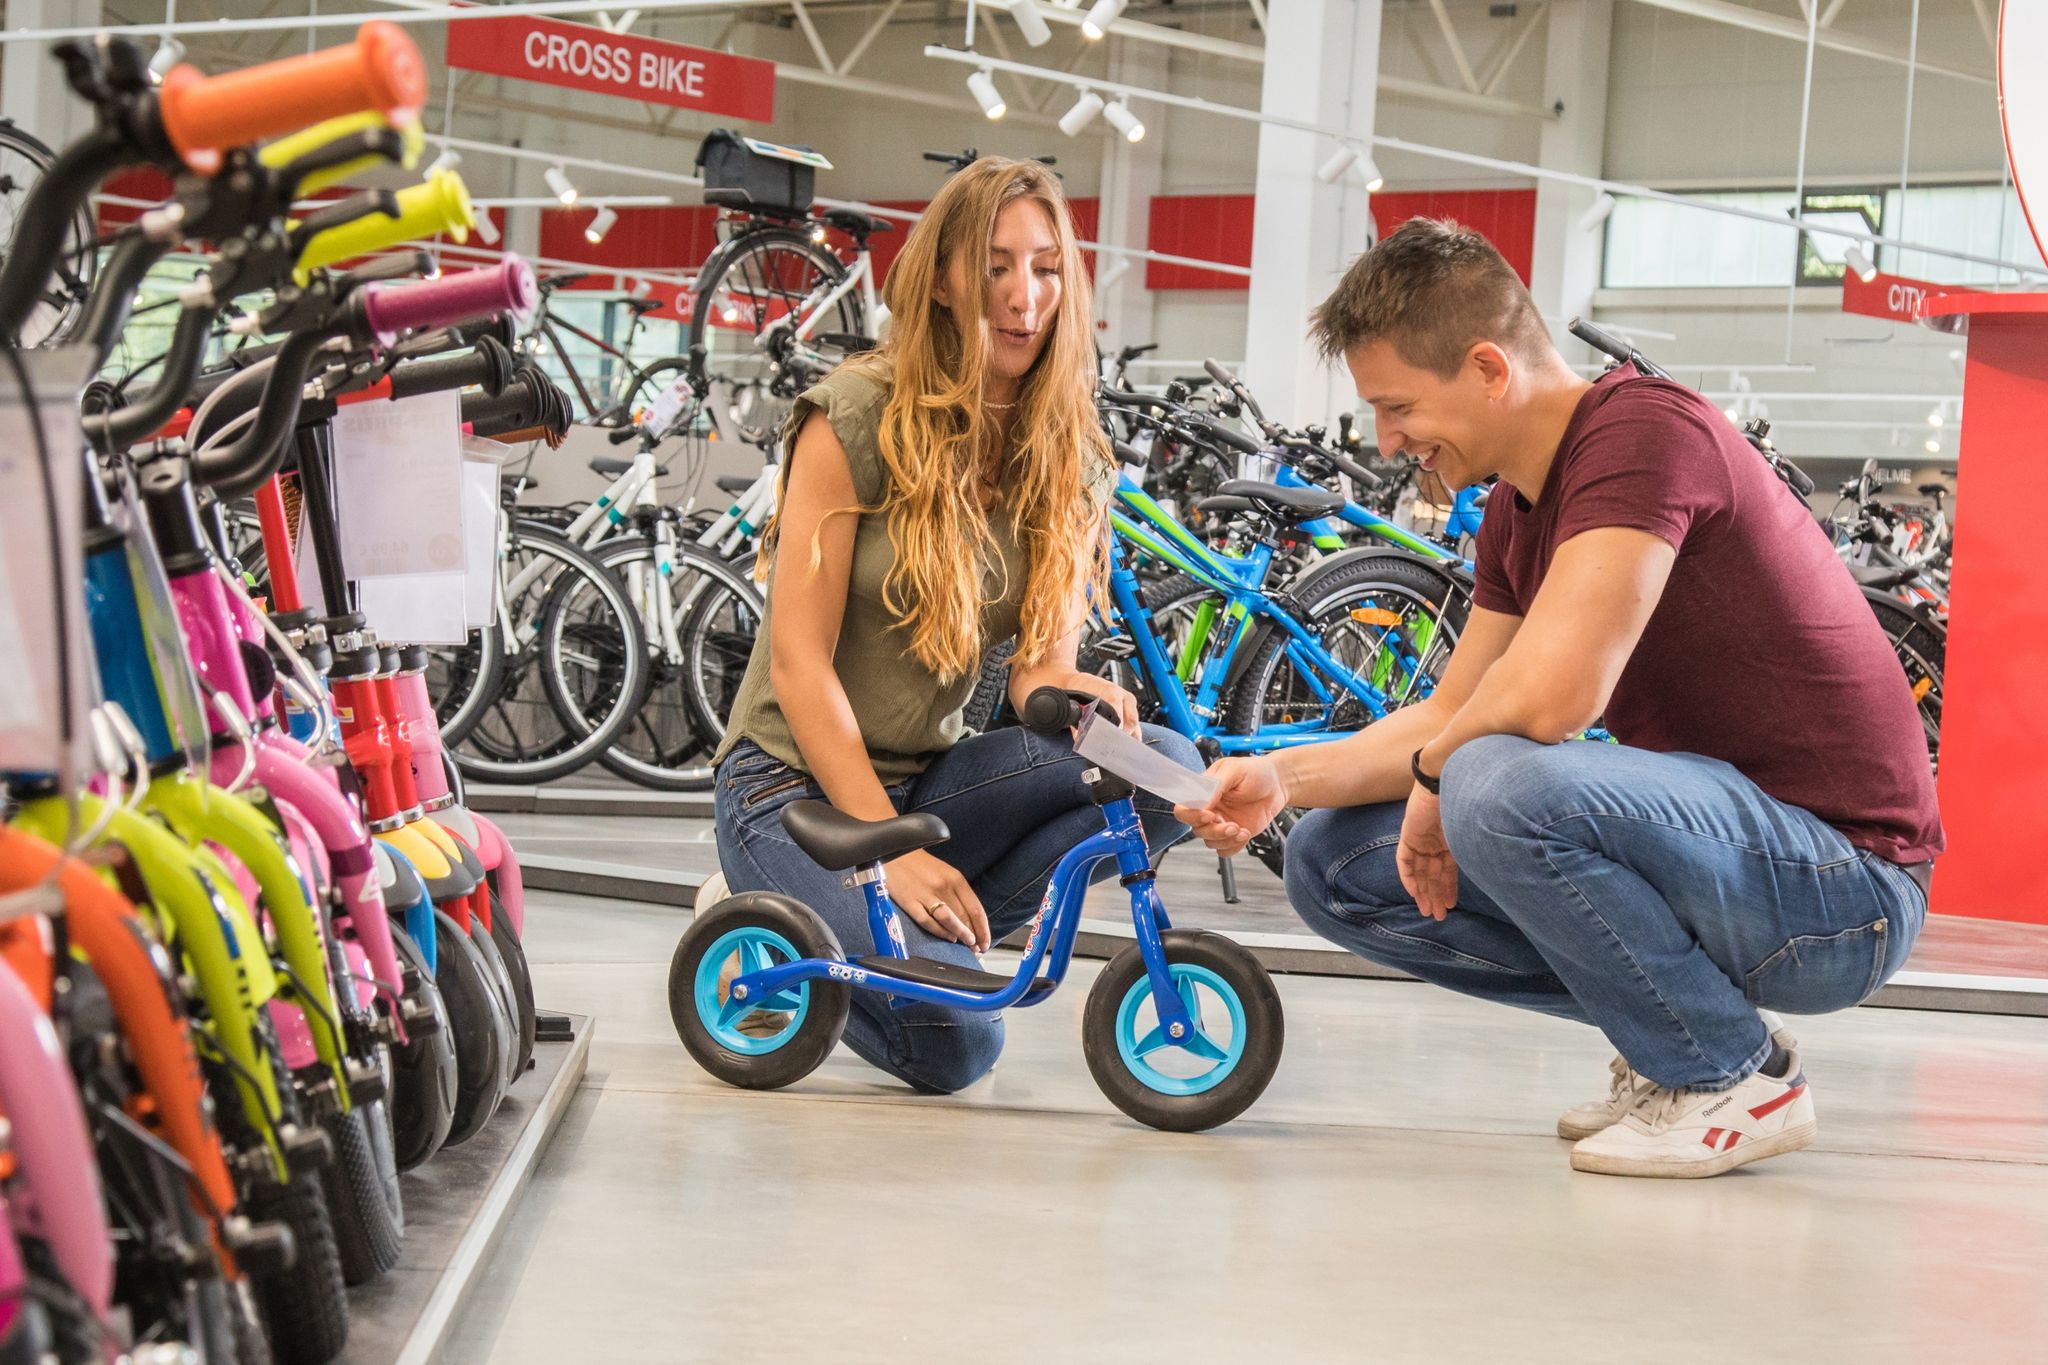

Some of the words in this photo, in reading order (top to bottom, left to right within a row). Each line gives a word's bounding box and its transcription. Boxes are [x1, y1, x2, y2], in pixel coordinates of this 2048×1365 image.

[525, 31, 632, 84] CROSS
[638, 52, 705, 97] BIKE
[1702, 1096, 1733, 1118] Reebok
